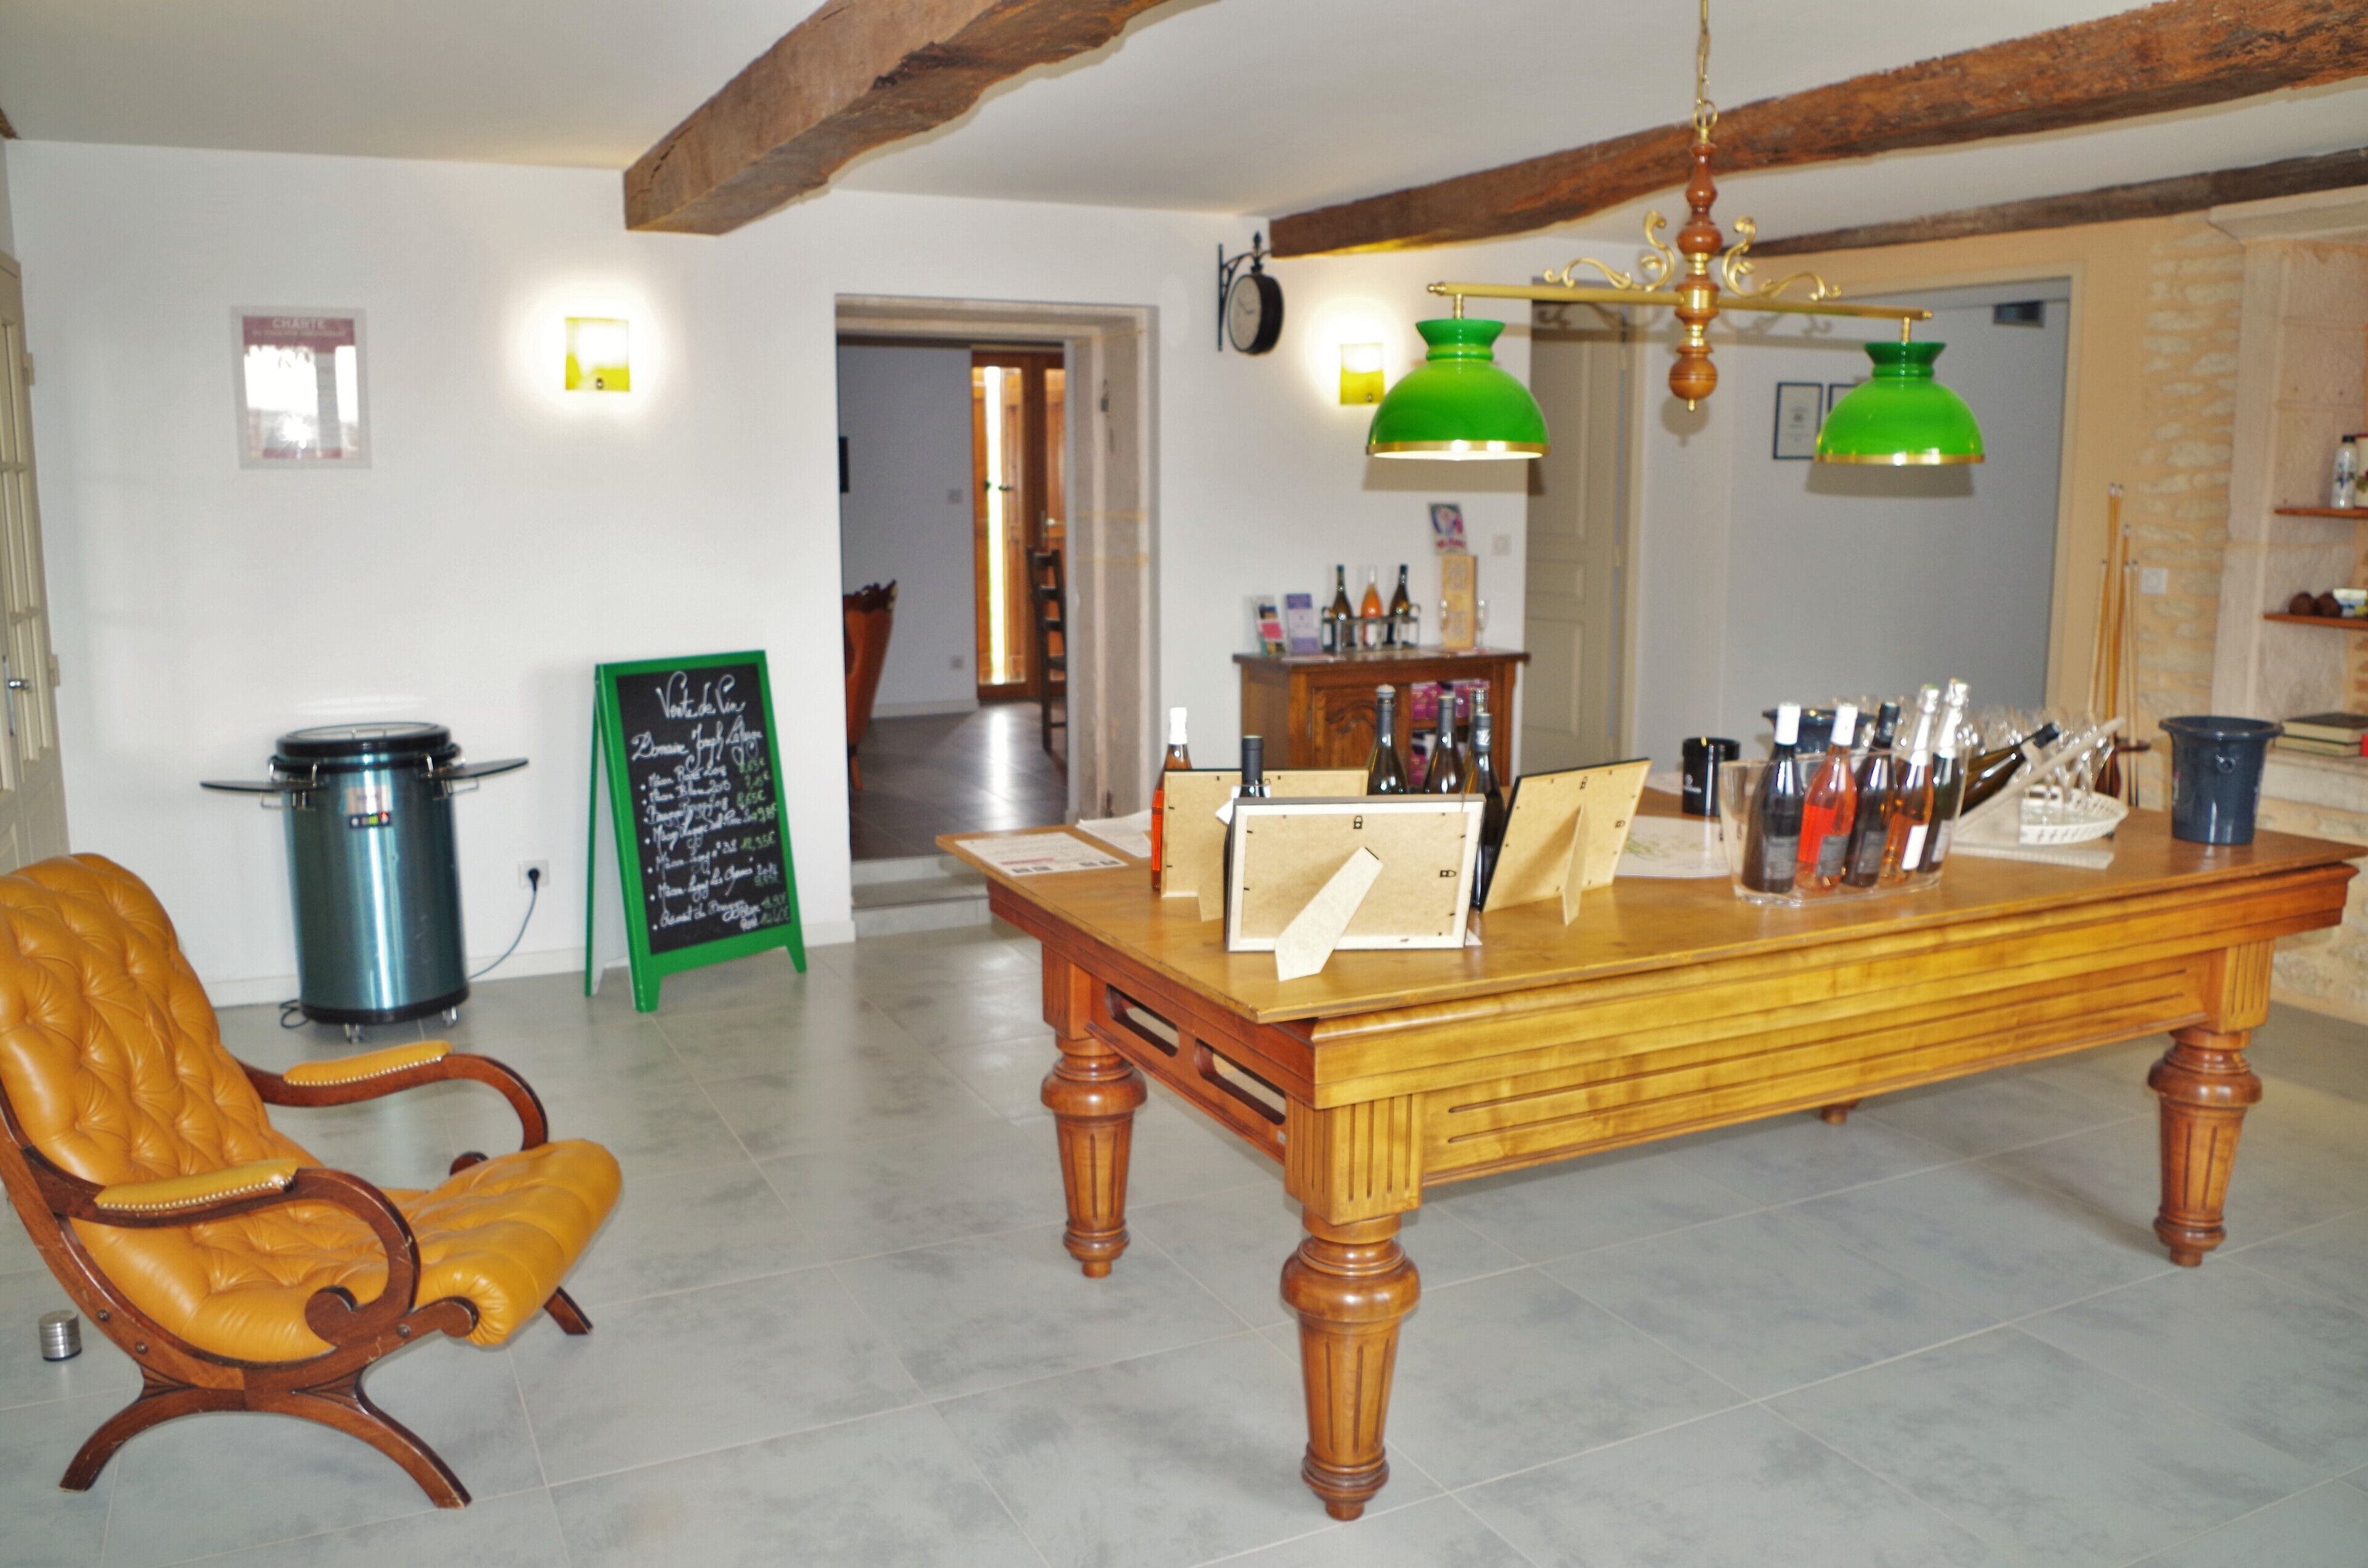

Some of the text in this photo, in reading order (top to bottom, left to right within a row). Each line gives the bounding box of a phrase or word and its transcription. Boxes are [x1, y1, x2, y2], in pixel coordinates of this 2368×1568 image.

[272, 318, 326, 329] CHARTE
[656, 670, 747, 720] Vente de Vin
[631, 731, 689, 761] Domaine
